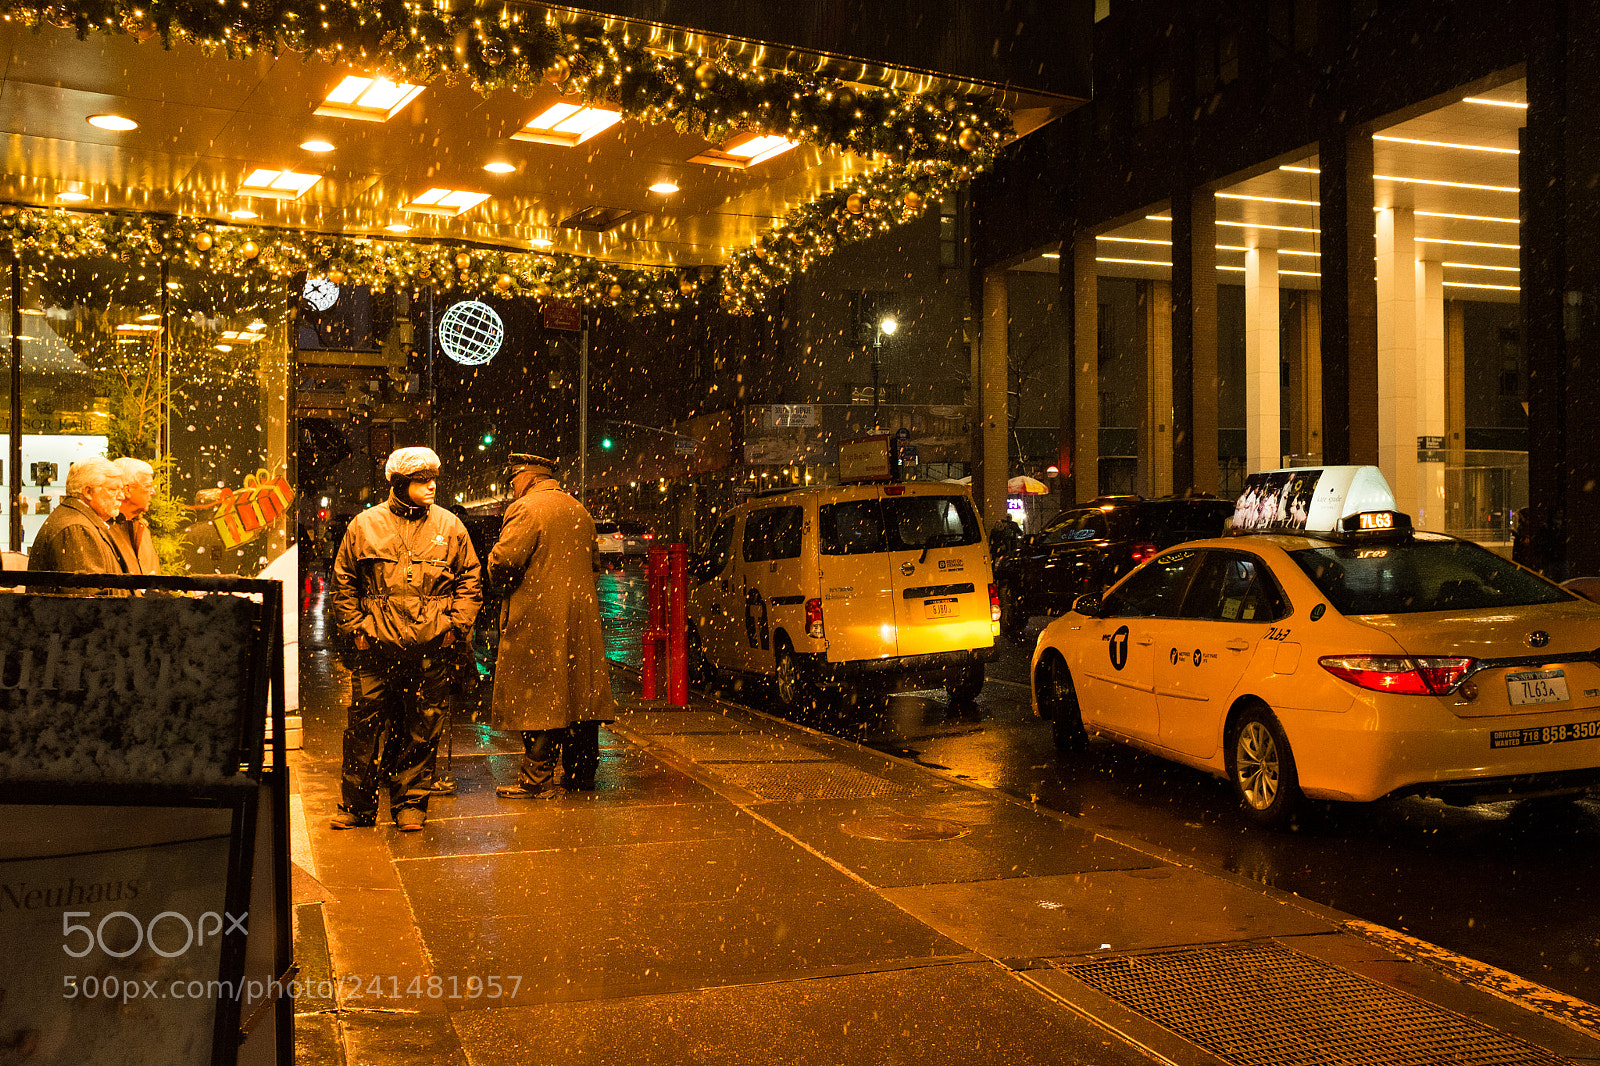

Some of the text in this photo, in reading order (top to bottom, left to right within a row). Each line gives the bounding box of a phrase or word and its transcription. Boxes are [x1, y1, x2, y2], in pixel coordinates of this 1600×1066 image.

[1360, 513, 1391, 529] 7L63
[1494, 730, 1520, 740] DRIVERS
[1523, 731, 1539, 742] 718
[1494, 739, 1520, 748] WANTED
[0, 877, 140, 911] Neuhaus
